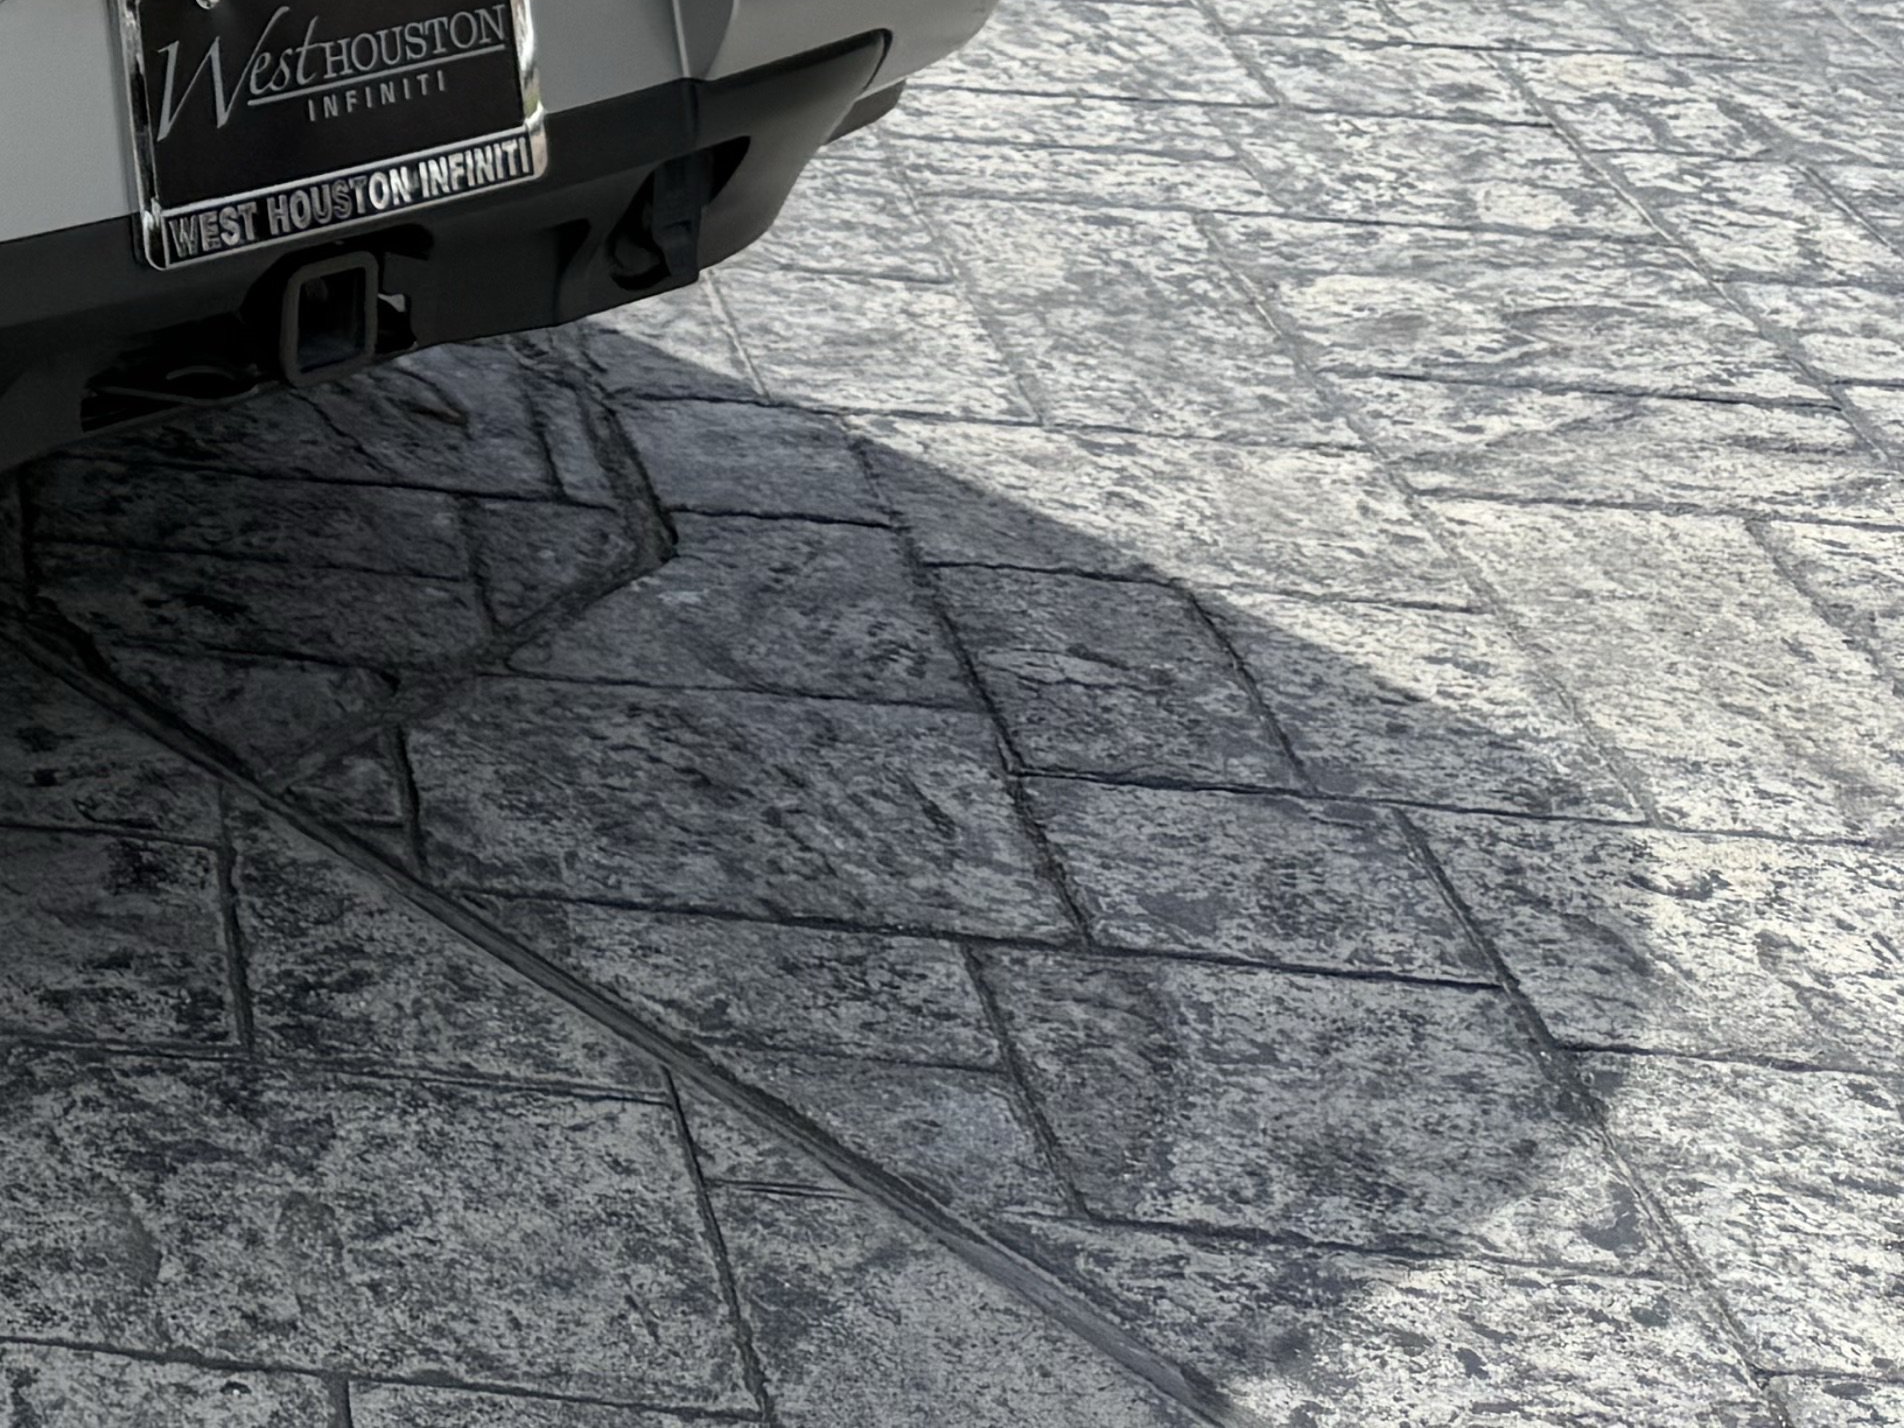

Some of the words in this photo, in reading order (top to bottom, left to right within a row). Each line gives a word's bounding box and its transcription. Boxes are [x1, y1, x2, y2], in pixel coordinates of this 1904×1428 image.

[308, 69, 446, 122] INFINITI
[169, 200, 259, 259] WEST
[267, 166, 410, 236] HOUSTON
[419, 134, 531, 199] INFINITI
